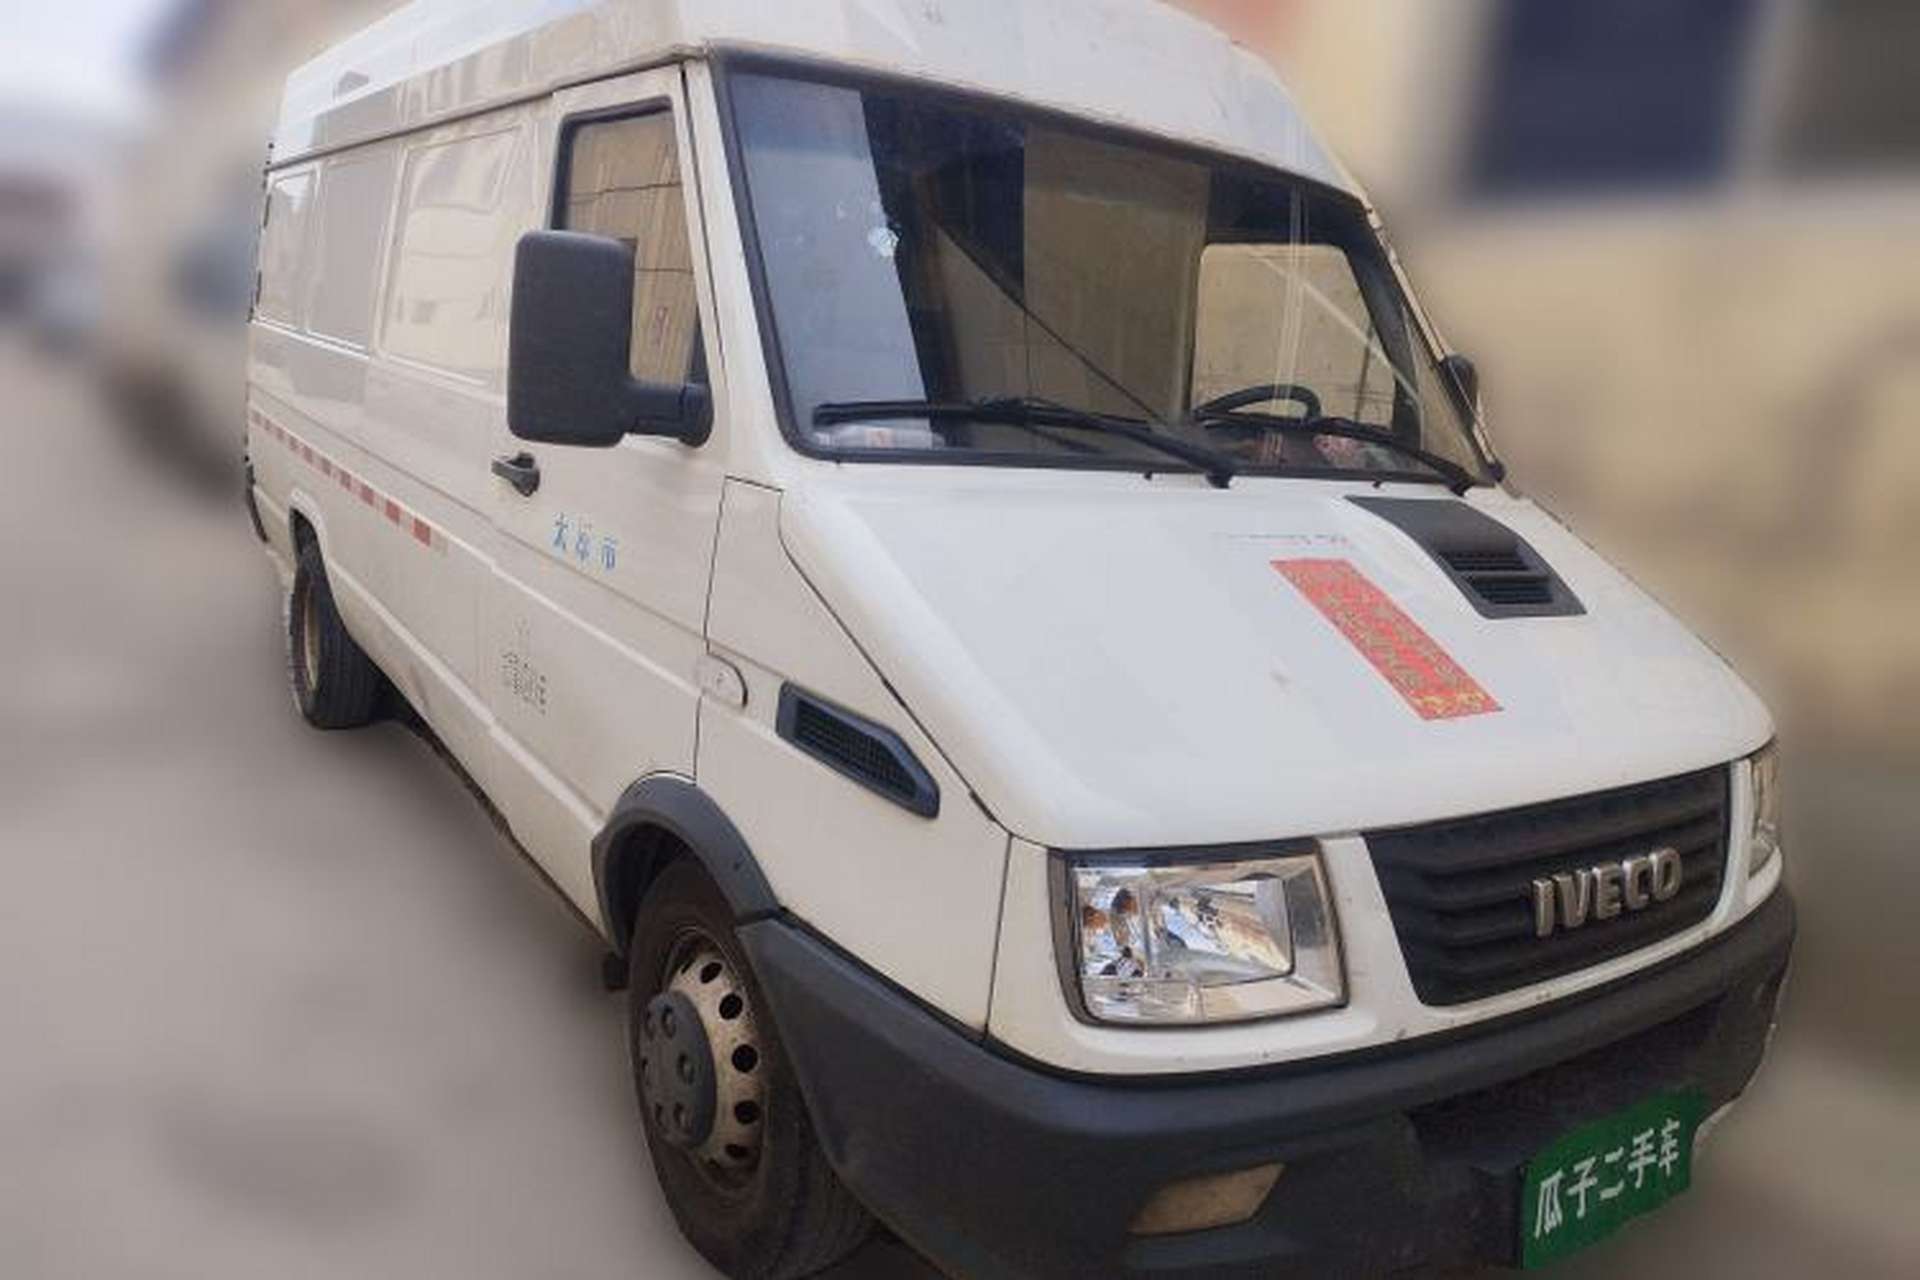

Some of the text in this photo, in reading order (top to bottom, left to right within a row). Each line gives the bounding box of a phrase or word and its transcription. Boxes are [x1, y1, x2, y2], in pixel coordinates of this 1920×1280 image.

[1533, 847, 1683, 938] IVECO
[1534, 1117, 1681, 1240] 瓜子二手车
